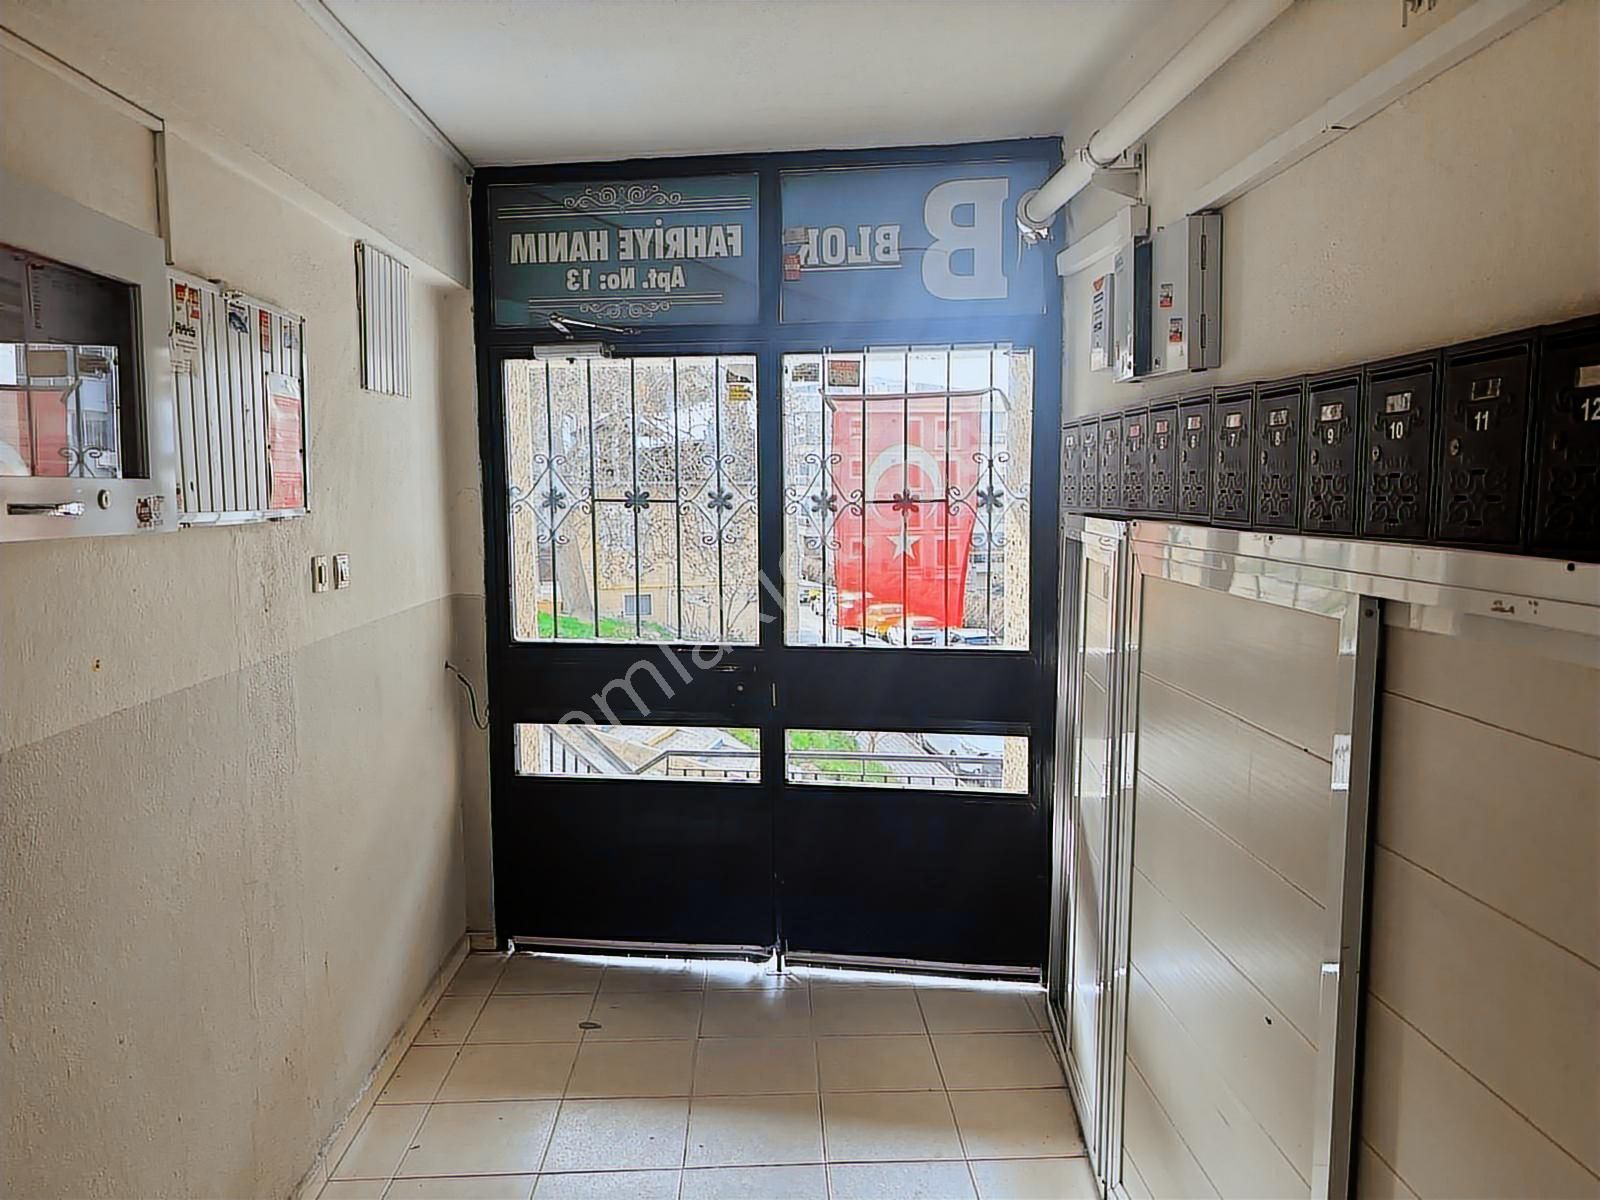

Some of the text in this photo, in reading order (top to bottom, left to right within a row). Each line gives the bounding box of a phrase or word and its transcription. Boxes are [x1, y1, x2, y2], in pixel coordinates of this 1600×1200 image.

[1580, 397, 1600, 421] 12
[1389, 421, 1404, 440] 10
[1474, 410, 1489, 432] 11
[1274, 431, 1281, 446] 8
[1326, 428, 1334, 444] 9
